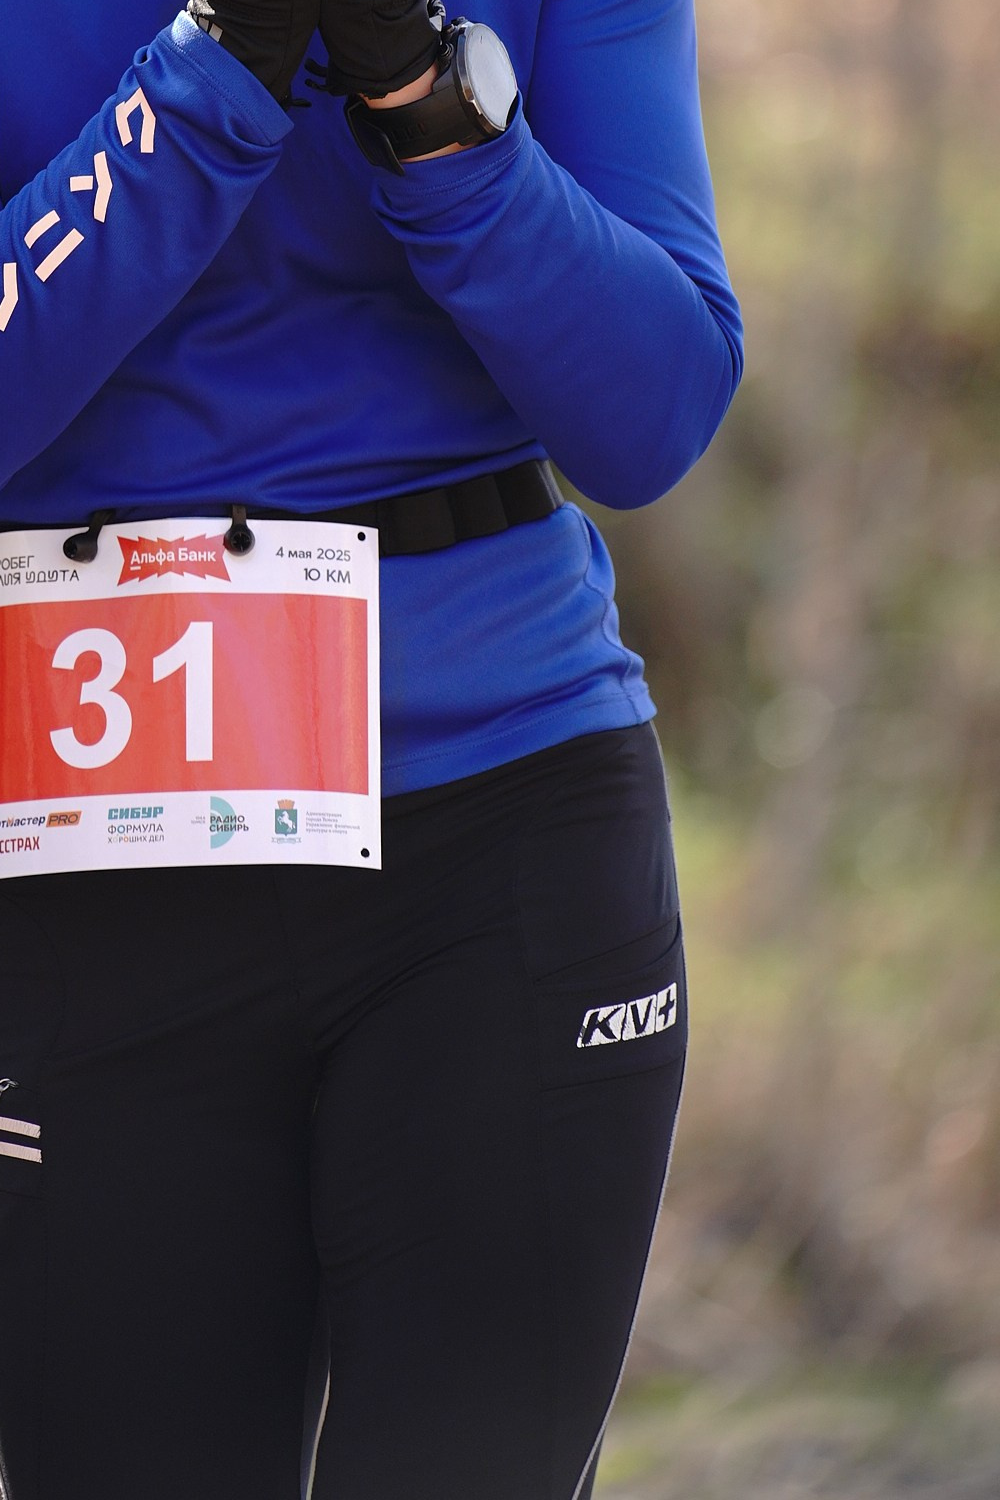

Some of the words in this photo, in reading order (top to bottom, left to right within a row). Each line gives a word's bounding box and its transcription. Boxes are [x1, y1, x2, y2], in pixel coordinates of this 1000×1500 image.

[130, 547, 175, 567] Альфа
[178, 547, 217, 563] Банк
[275, 546, 284, 559] 4
[288, 550, 312, 559] мая
[316, 548, 351, 562] 2025
[303, 567, 321, 581] 10
[326, 568, 351, 584] КМ
[49, 621, 214, 770] 31
[48, 813, 79, 827] PRO
[107, 806, 164, 820] СИБУР
[210, 815, 245, 824] РАДИО
[107, 823, 164, 835] ФОРМУЛА
[209, 824, 249, 833] СИБИРЬ
[148, 834, 165, 844] ДЕЛ
